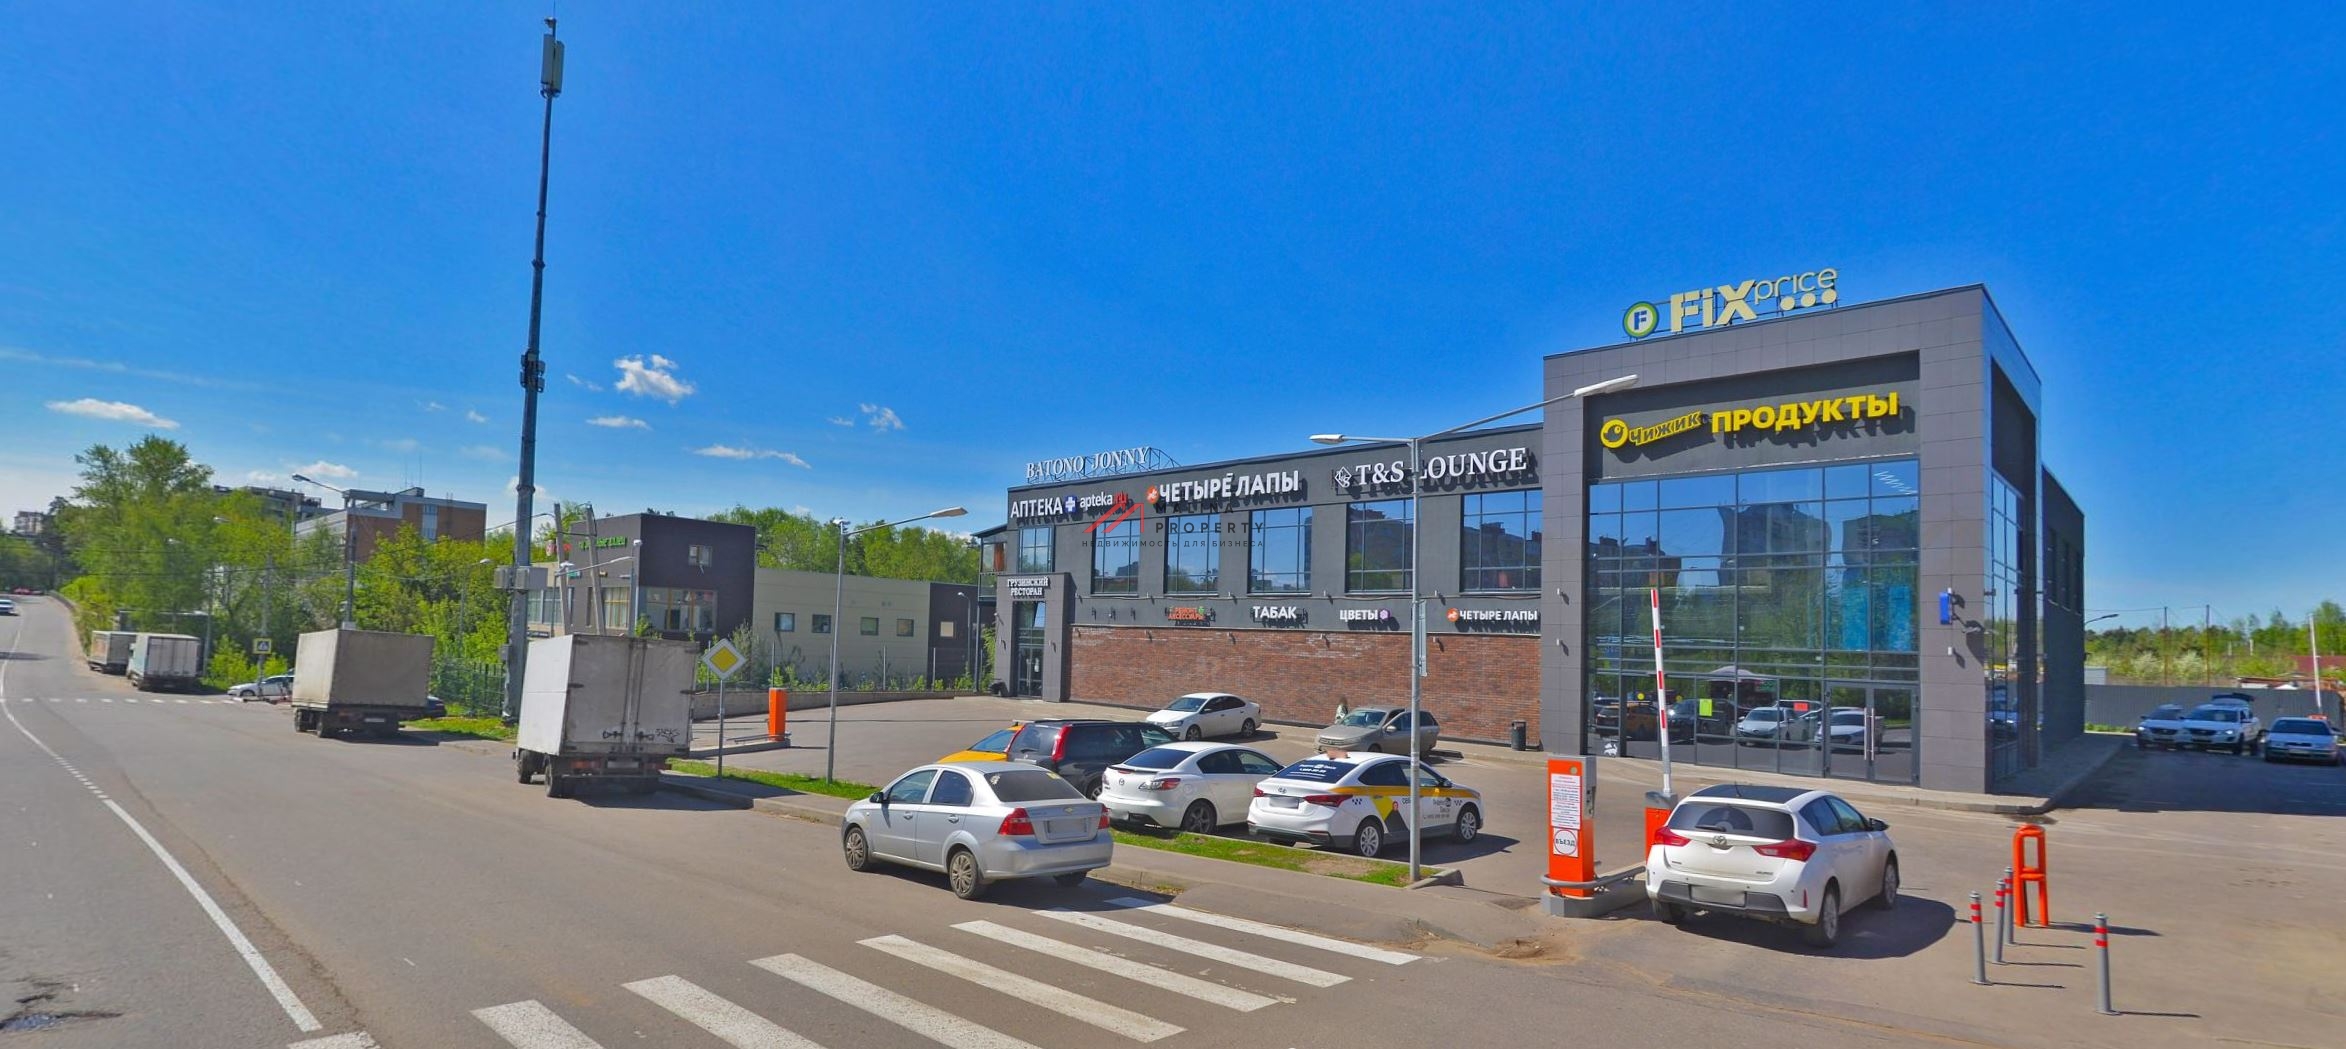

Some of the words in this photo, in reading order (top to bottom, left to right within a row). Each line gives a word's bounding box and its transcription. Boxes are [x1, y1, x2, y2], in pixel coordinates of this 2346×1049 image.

[1754, 268, 1837, 304] price
[1712, 392, 1898, 433] ПРОДУКТЫ
[1026, 455, 1084, 479] BATONO
[1091, 446, 1150, 470] JONNY
[1356, 461, 1404, 485] T&S
[1235, 470, 1299, 496] ЛАПЫ
[1010, 497, 1063, 518] АПТЕКА
[1010, 587, 1042, 596] РЕСТОРАН
[1253, 606, 1297, 618] ТАБАК
[1339, 610, 1378, 621] ЦВЕТЫ
[1459, 610, 1501, 621] ЧЕТЫРЕ
[1503, 610, 1538, 621] ЛАПЫ
